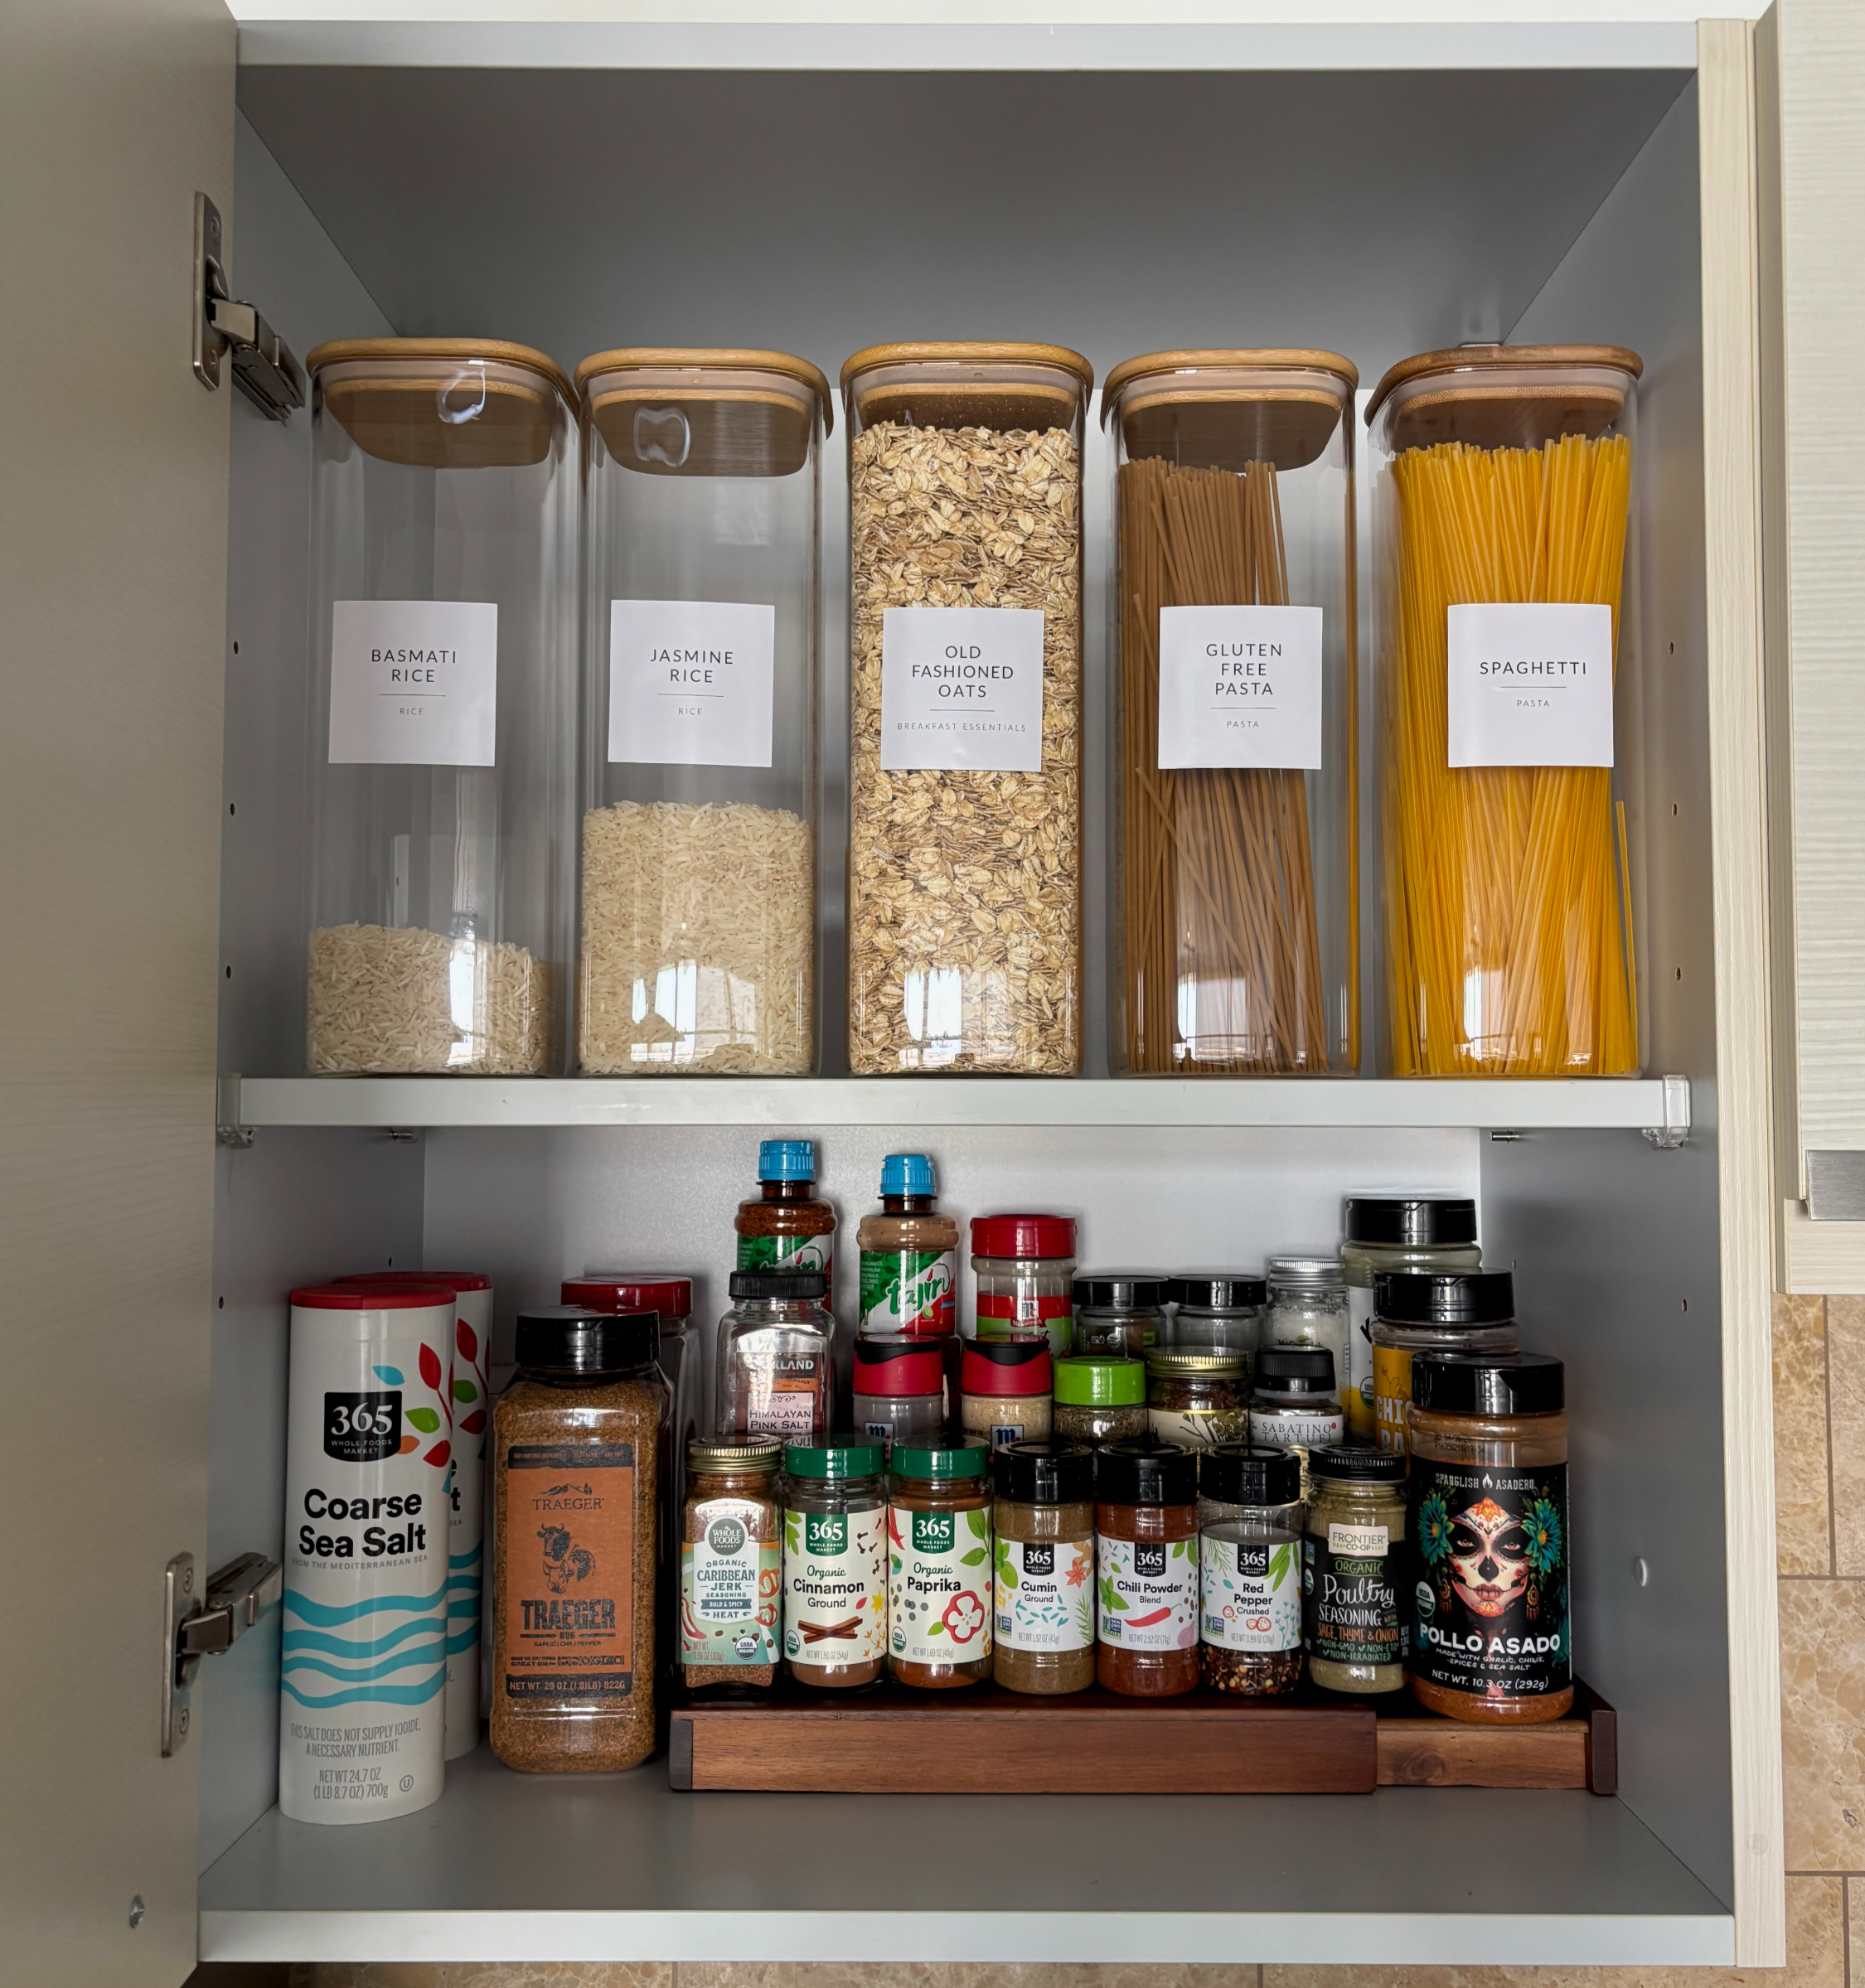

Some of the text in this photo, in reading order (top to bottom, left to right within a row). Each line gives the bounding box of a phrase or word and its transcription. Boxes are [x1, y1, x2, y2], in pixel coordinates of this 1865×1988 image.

[371, 649, 456, 664] BASMATI
[650, 649, 734, 665] JASMINE
[945, 646, 981, 659] OLD
[1206, 644, 1282, 656] GLUTEN
[912, 665, 1014, 679] FASHIONED
[1221, 663, 1267, 675] FREE
[1480, 661, 1586, 675] SPAGHETTI
[392, 669, 435, 683] RICE
[670, 669, 714, 683] RICE
[938, 684, 986, 698] OATS
[1215, 683, 1273, 695] PASTA
[963, 723, 1026, 732] ESSENTIALS
[331, 1402, 393, 1435] 365
[749, 1410, 811, 1419] HIMALAYAN
[750, 1420, 810, 1429] PINK SALT
[1262, 1422, 1331, 1434] SABATINO
[1262, 1432, 1331, 1443] TARTUFI
[1436, 1473, 1479, 1489] SPANGLISH
[304, 1488, 422, 1520] Coarse
[532, 1498, 602, 1510] TRAEGER
[809, 1521, 843, 1541] 365
[916, 1518, 950, 1538] 365
[299, 1522, 426, 1558] Sea Salt
[1333, 1532, 1383, 1544] FRONTIER
[331, 1558, 411, 1570] MEDITERRANEAN
[414, 1555, 428, 1564] SEA
[706, 1560, 747, 1568] ORGANIC
[1025, 1550, 1051, 1565] 365
[1137, 1551, 1163, 1566] 365
[1240, 1551, 1266, 1566] 365
[807, 1565, 846, 1580] Organic
[913, 1562, 953, 1578] Organic
[1335, 1560, 1383, 1574] ORGANIC
[697, 1570, 755, 1581] CARIBBEAN
[710, 1583, 742, 1591] JERK
[793, 1578, 865, 1594] Cinnamon
[908, 1576, 961, 1594] Paprika
[1021, 1581, 1057, 1592] Cumin
[1117, 1580, 1183, 1594] Chili Powder
[1243, 1583, 1263, 1593] Red
[1323, 1574, 1396, 1608] Poultry
[807, 1597, 846, 1608] Ground
[1025, 1594, 1054, 1603] Ground
[1234, 1594, 1273, 1607] Pepper
[521, 1599, 615, 1630] TRAEGER
[1237, 1607, 1269, 1615] Crushed
[1319, 1603, 1382, 1626] SEASONING
[1042, 1634, 1048, 1642] OZ
[1155, 1635, 1160, 1643] OZ
[1318, 1622, 1337, 1640] SAGE,
[1338, 1626, 1366, 1642] THYME
[1368, 1631, 1374, 1640] &
[1375, 1627, 1398, 1642] ONION
[1420, 1623, 1483, 1652] POLLO
[1489, 1634, 1560, 1655] ASADO
[937, 1648, 942, 1657] OZ
[1323, 1640, 1354, 1651] NON-GMO
[704, 1652, 710, 1660] OZ
[831, 1651, 836, 1660] OZ
[1330, 1650, 1392, 1662] NON-IRRADIATED
[1436, 1647, 1456, 1657] MADE
[1458, 1652, 1480, 1662] WITH
[1449, 1659, 1477, 1668] SPICES
[557, 1681, 567, 1690] OZ
[1431, 1669, 1548, 1691] NET WT. 10.3 OZ (292g)
[290, 1718, 420, 1741] THIS SALT DOES NOT SUPPLY IODIDE,
[306, 1739, 400, 1758] A NECESSARY NUTRIENT.
[320, 1768, 381, 1782] NET WT 24.7 OZ
[313, 1783, 388, 1799] (1 LB 8.7 OZ) 700g
